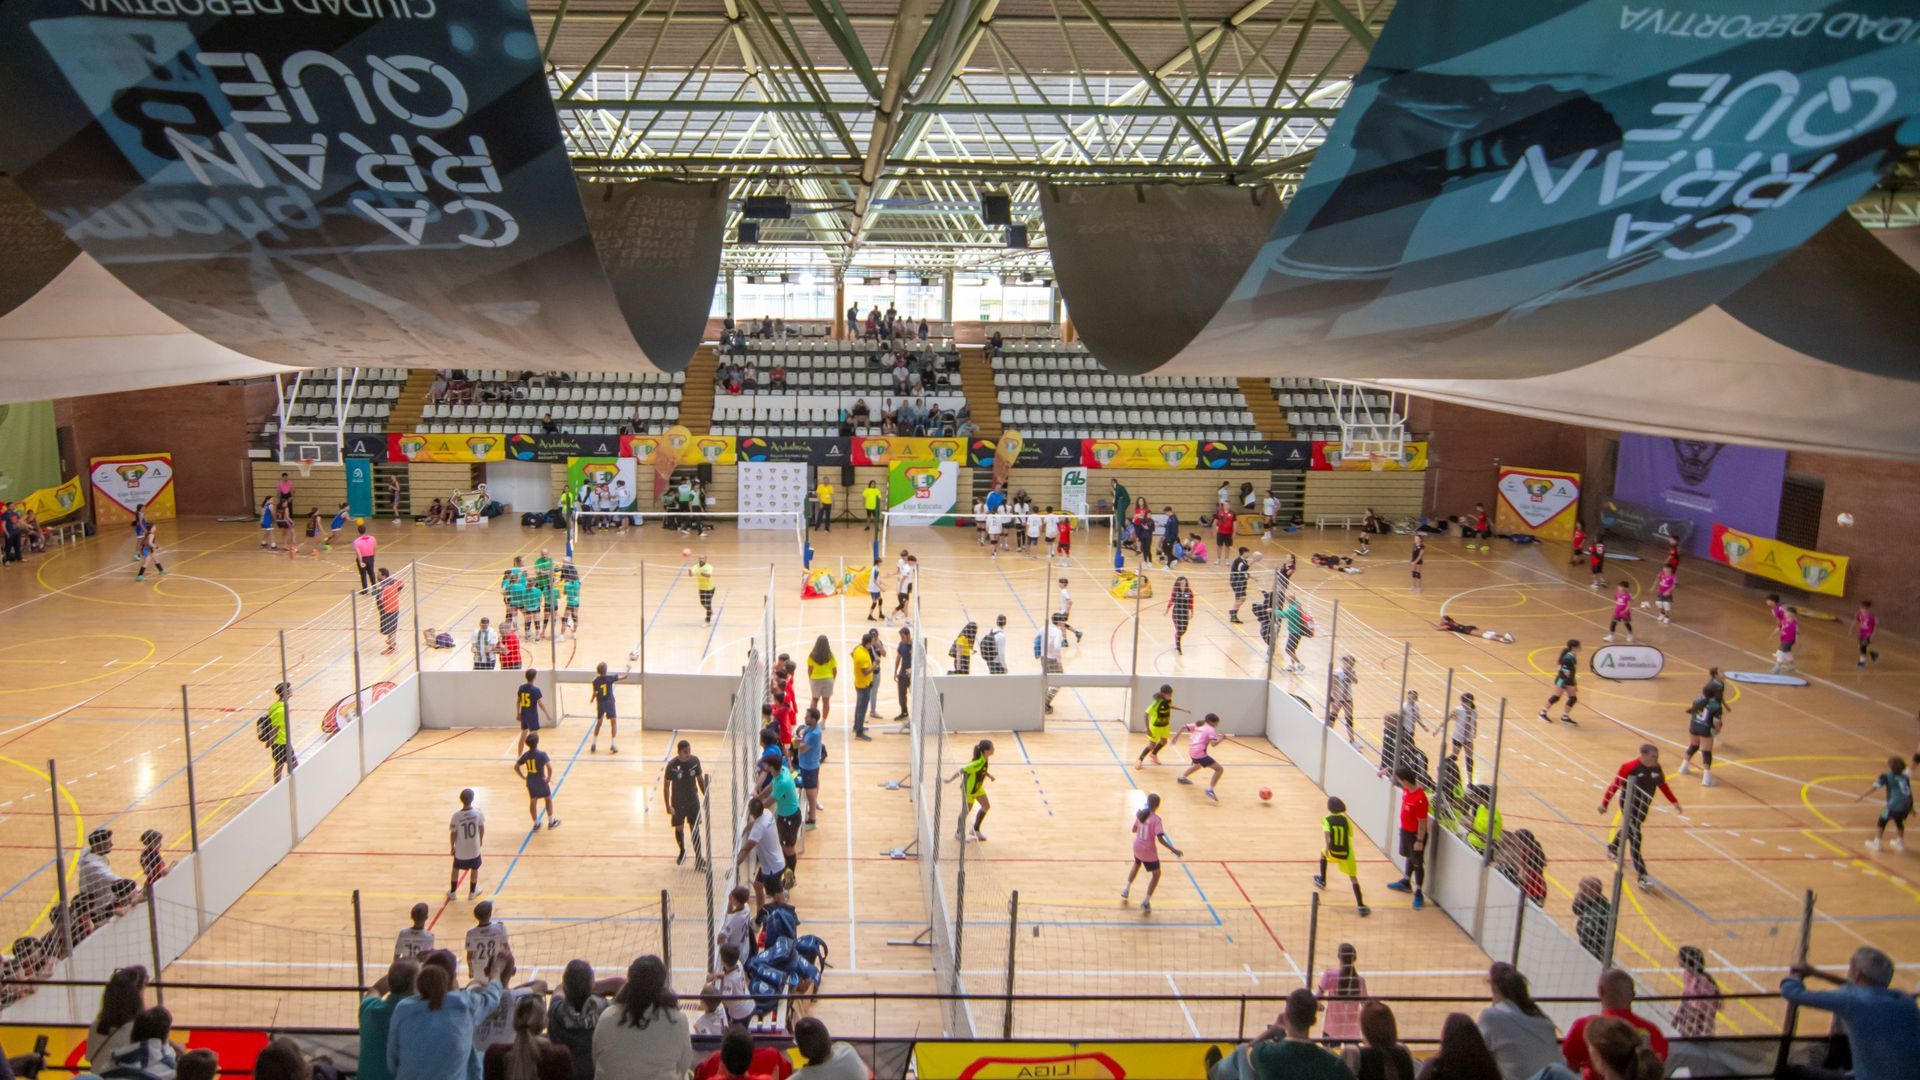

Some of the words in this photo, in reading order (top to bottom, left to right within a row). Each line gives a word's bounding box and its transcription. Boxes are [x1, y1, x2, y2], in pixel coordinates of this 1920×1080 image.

[1620, 5, 1823, 39] DEPORTIVA
[195, 49, 468, 129] QUE
[1622, 70, 1897, 148] QUE
[164, 127, 503, 193] RRAN
[1489, 144, 1838, 208] RRAN
[352, 198, 519, 248] CA
[1607, 213, 1753, 260] CA
[521, 692, 531, 708] 15
[526, 759, 538, 774] 11
[461, 821, 477, 840] 10
[1332, 825, 1345, 846] 11
